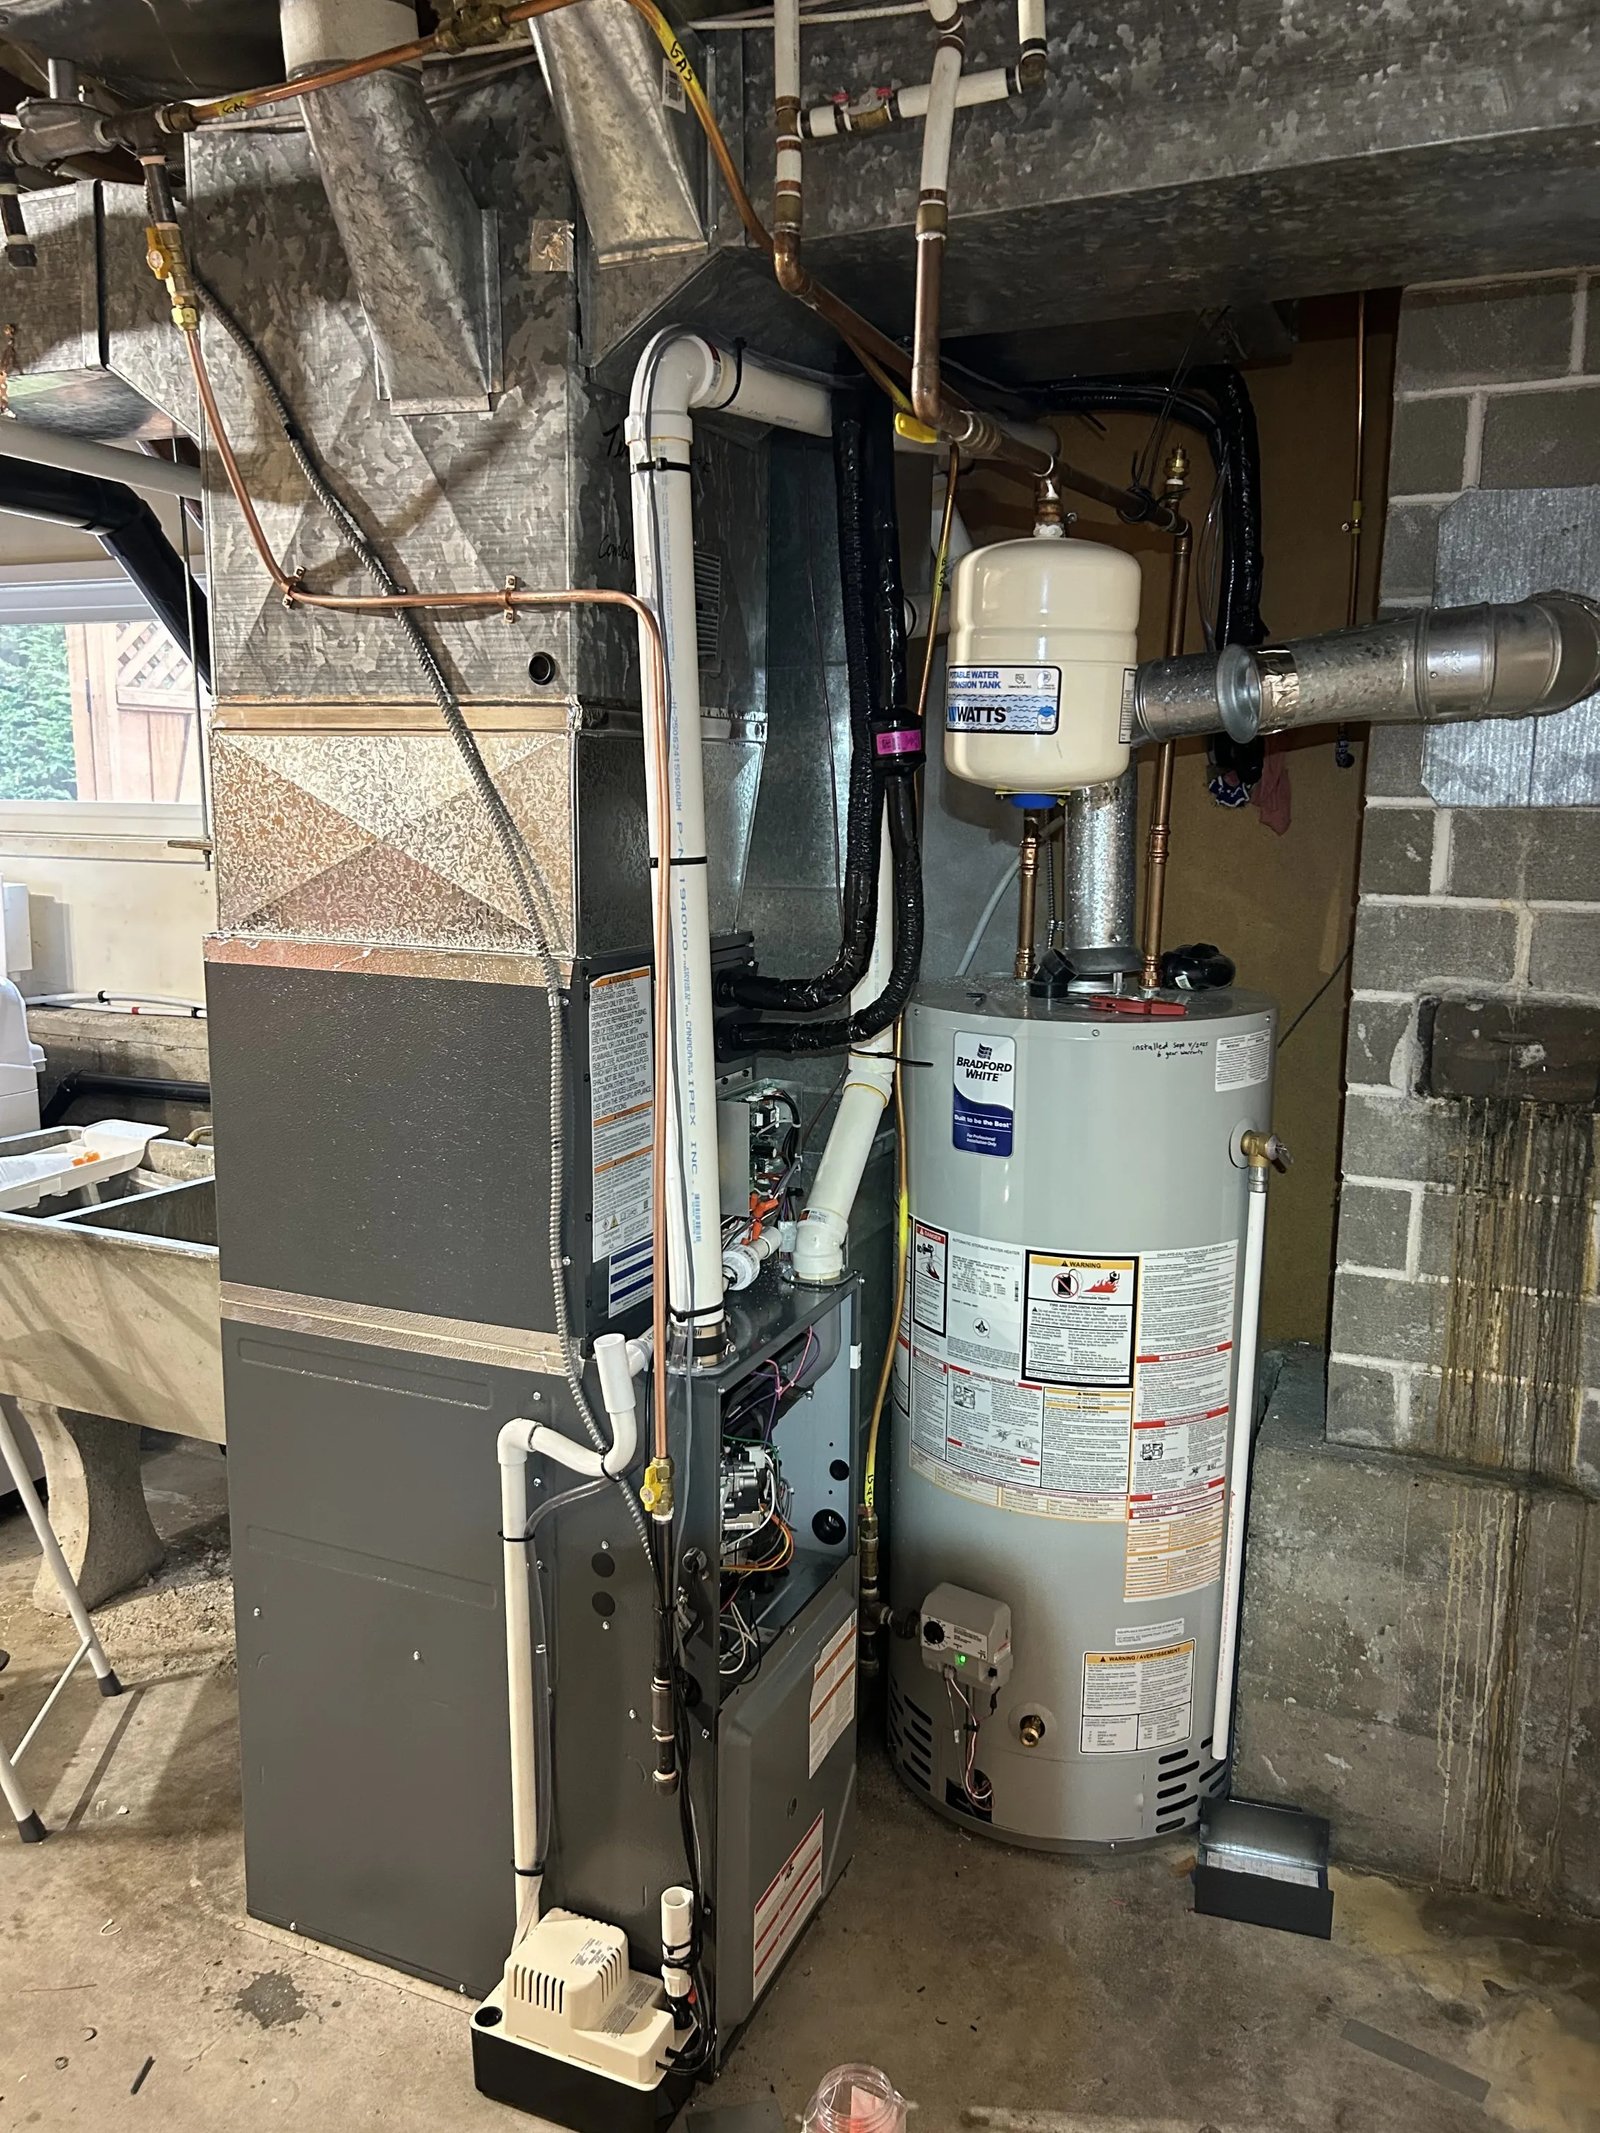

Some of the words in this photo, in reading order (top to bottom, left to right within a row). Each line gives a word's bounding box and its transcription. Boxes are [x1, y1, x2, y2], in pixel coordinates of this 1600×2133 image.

[670, 40, 693, 82] GAS
[222, 100, 247, 113] GAS
[971, 671, 999, 679] WATER
[978, 681, 1001, 689] TANK
[957, 707, 1006, 723] WATTS
[679, 877, 688, 951] 194000
[1132, 1042, 1168, 1051] installed
[956, 1056, 1012, 1072] BRADFORD
[965, 1068, 999, 1081] WHITE
[688, 1079, 696, 1127] IPEX
[690, 1141, 698, 1184] INC.
[924, 1230, 942, 1242] DANGER
[1070, 1261, 1101, 1269] WARNING
[1140, 1648, 1180, 1660] AVERTISSEMENT
